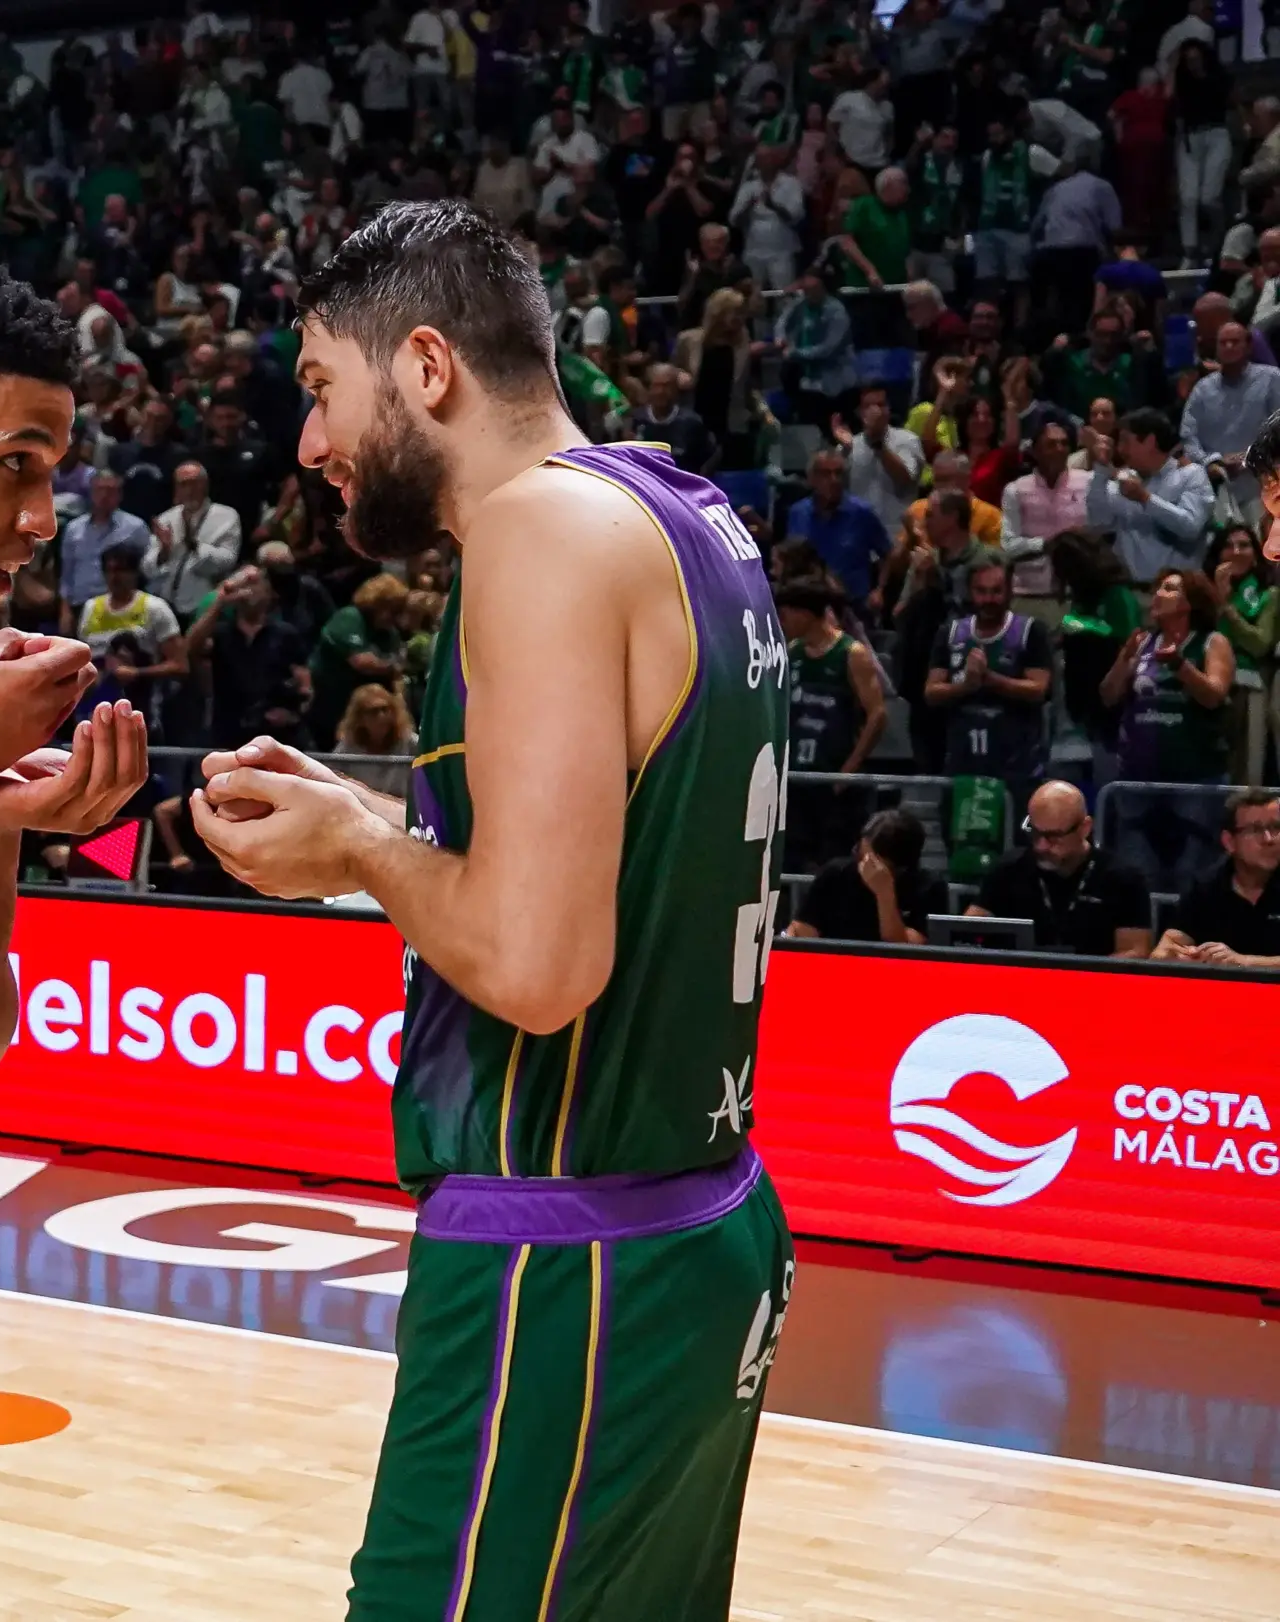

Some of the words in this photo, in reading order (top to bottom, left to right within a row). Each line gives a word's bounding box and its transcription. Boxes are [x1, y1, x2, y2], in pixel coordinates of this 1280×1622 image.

[8, 952, 406, 1086] elsol.co
[1113, 1084, 1271, 1131] COSTA
[1113, 1124, 1280, 1176] MÁLAG
